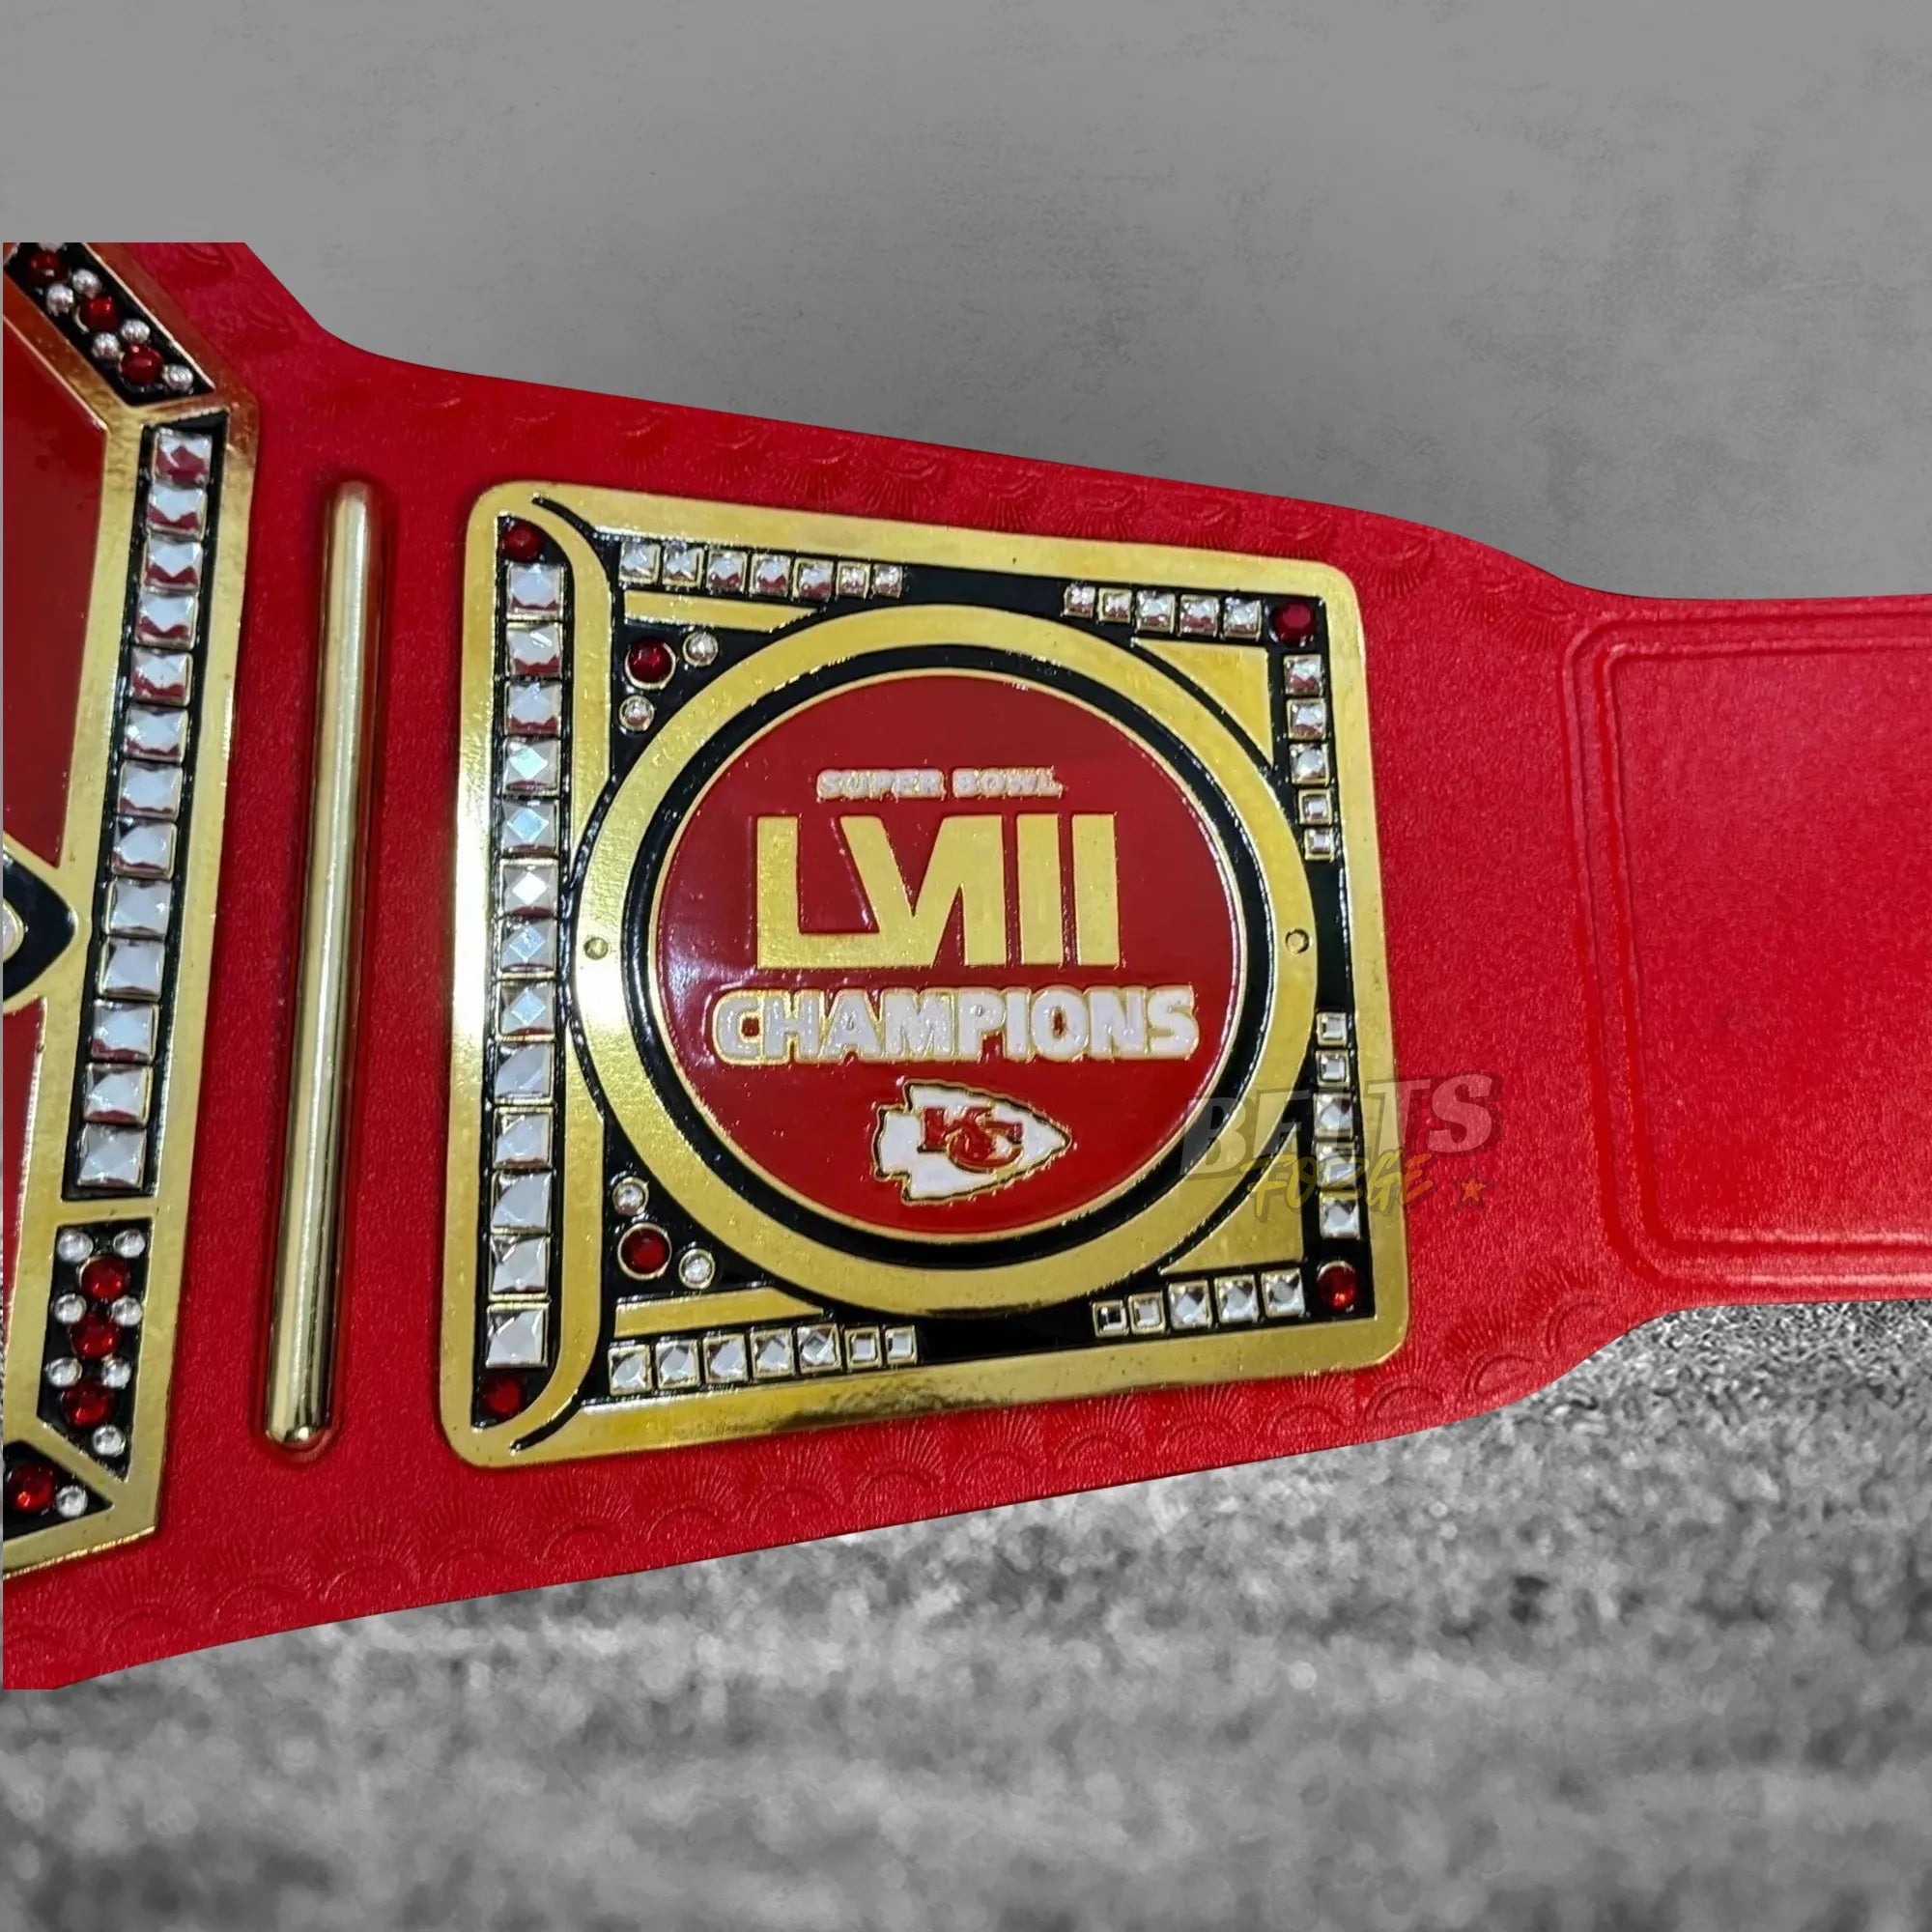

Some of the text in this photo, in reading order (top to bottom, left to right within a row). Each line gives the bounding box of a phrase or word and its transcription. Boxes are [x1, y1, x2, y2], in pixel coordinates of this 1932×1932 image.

[817, 767, 1063, 801] SUPER BOWL
[713, 986, 1200, 1065] CHAMPIONS
[918, 1106, 1025, 1172] KC
